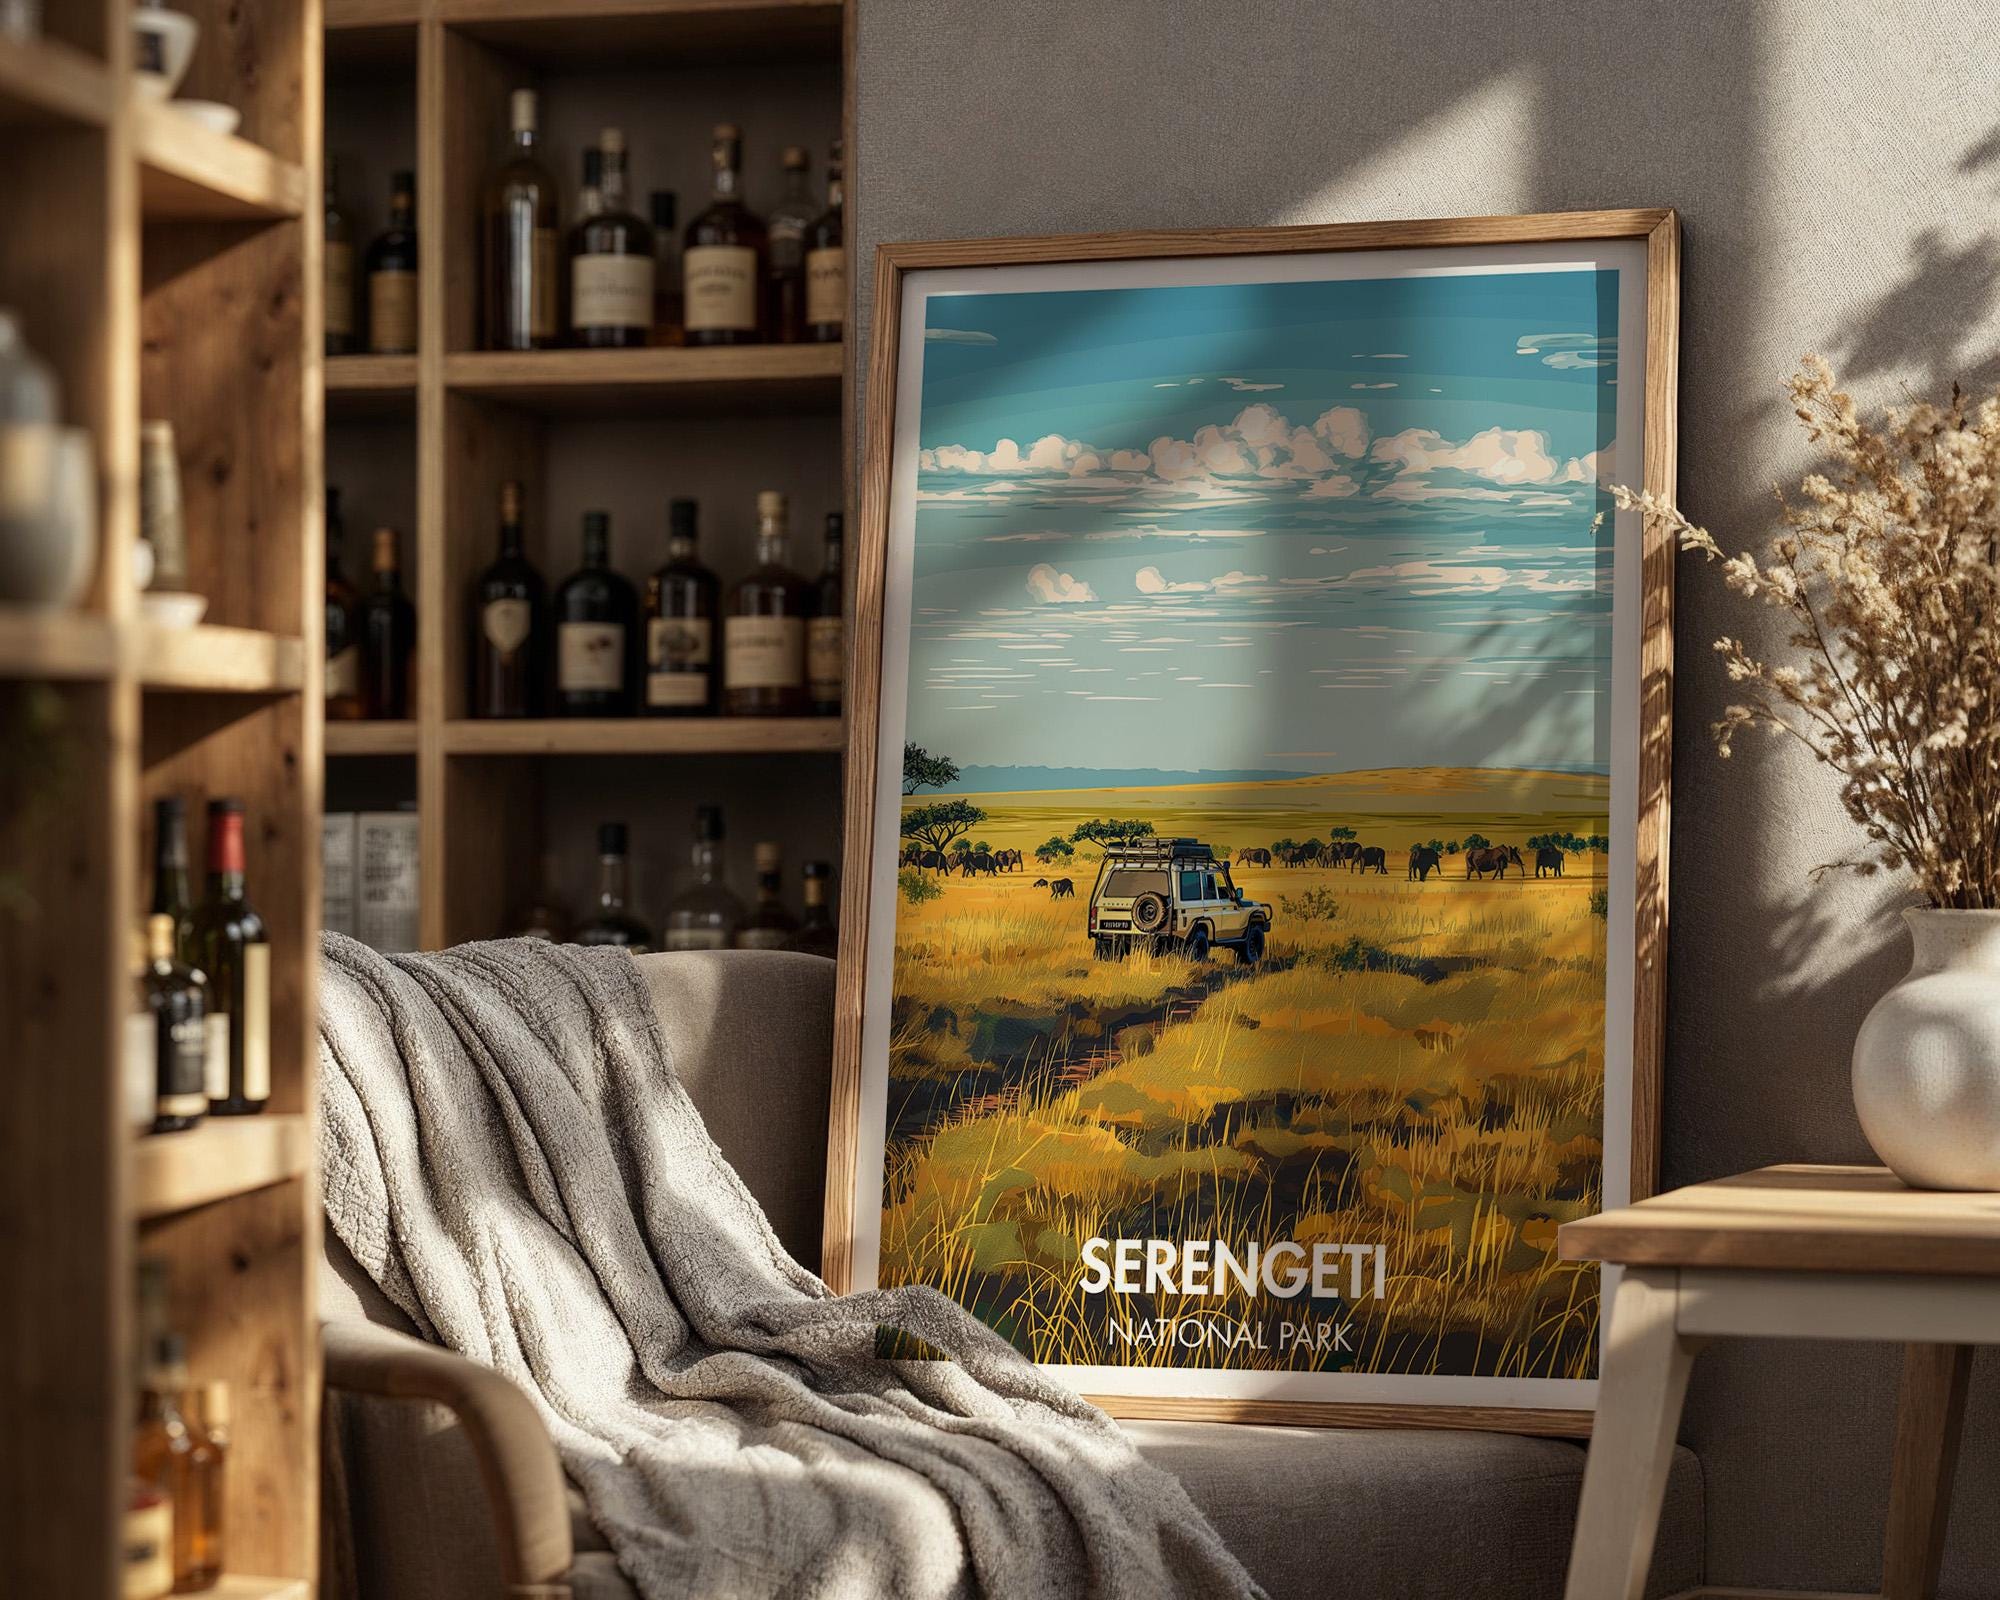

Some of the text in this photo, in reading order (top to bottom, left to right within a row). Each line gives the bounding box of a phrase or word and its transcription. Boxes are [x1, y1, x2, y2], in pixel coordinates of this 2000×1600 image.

[1079, 1237, 1387, 1300] SERENGETI
[1108, 1317, 1354, 1352] NATIONAL PARK
